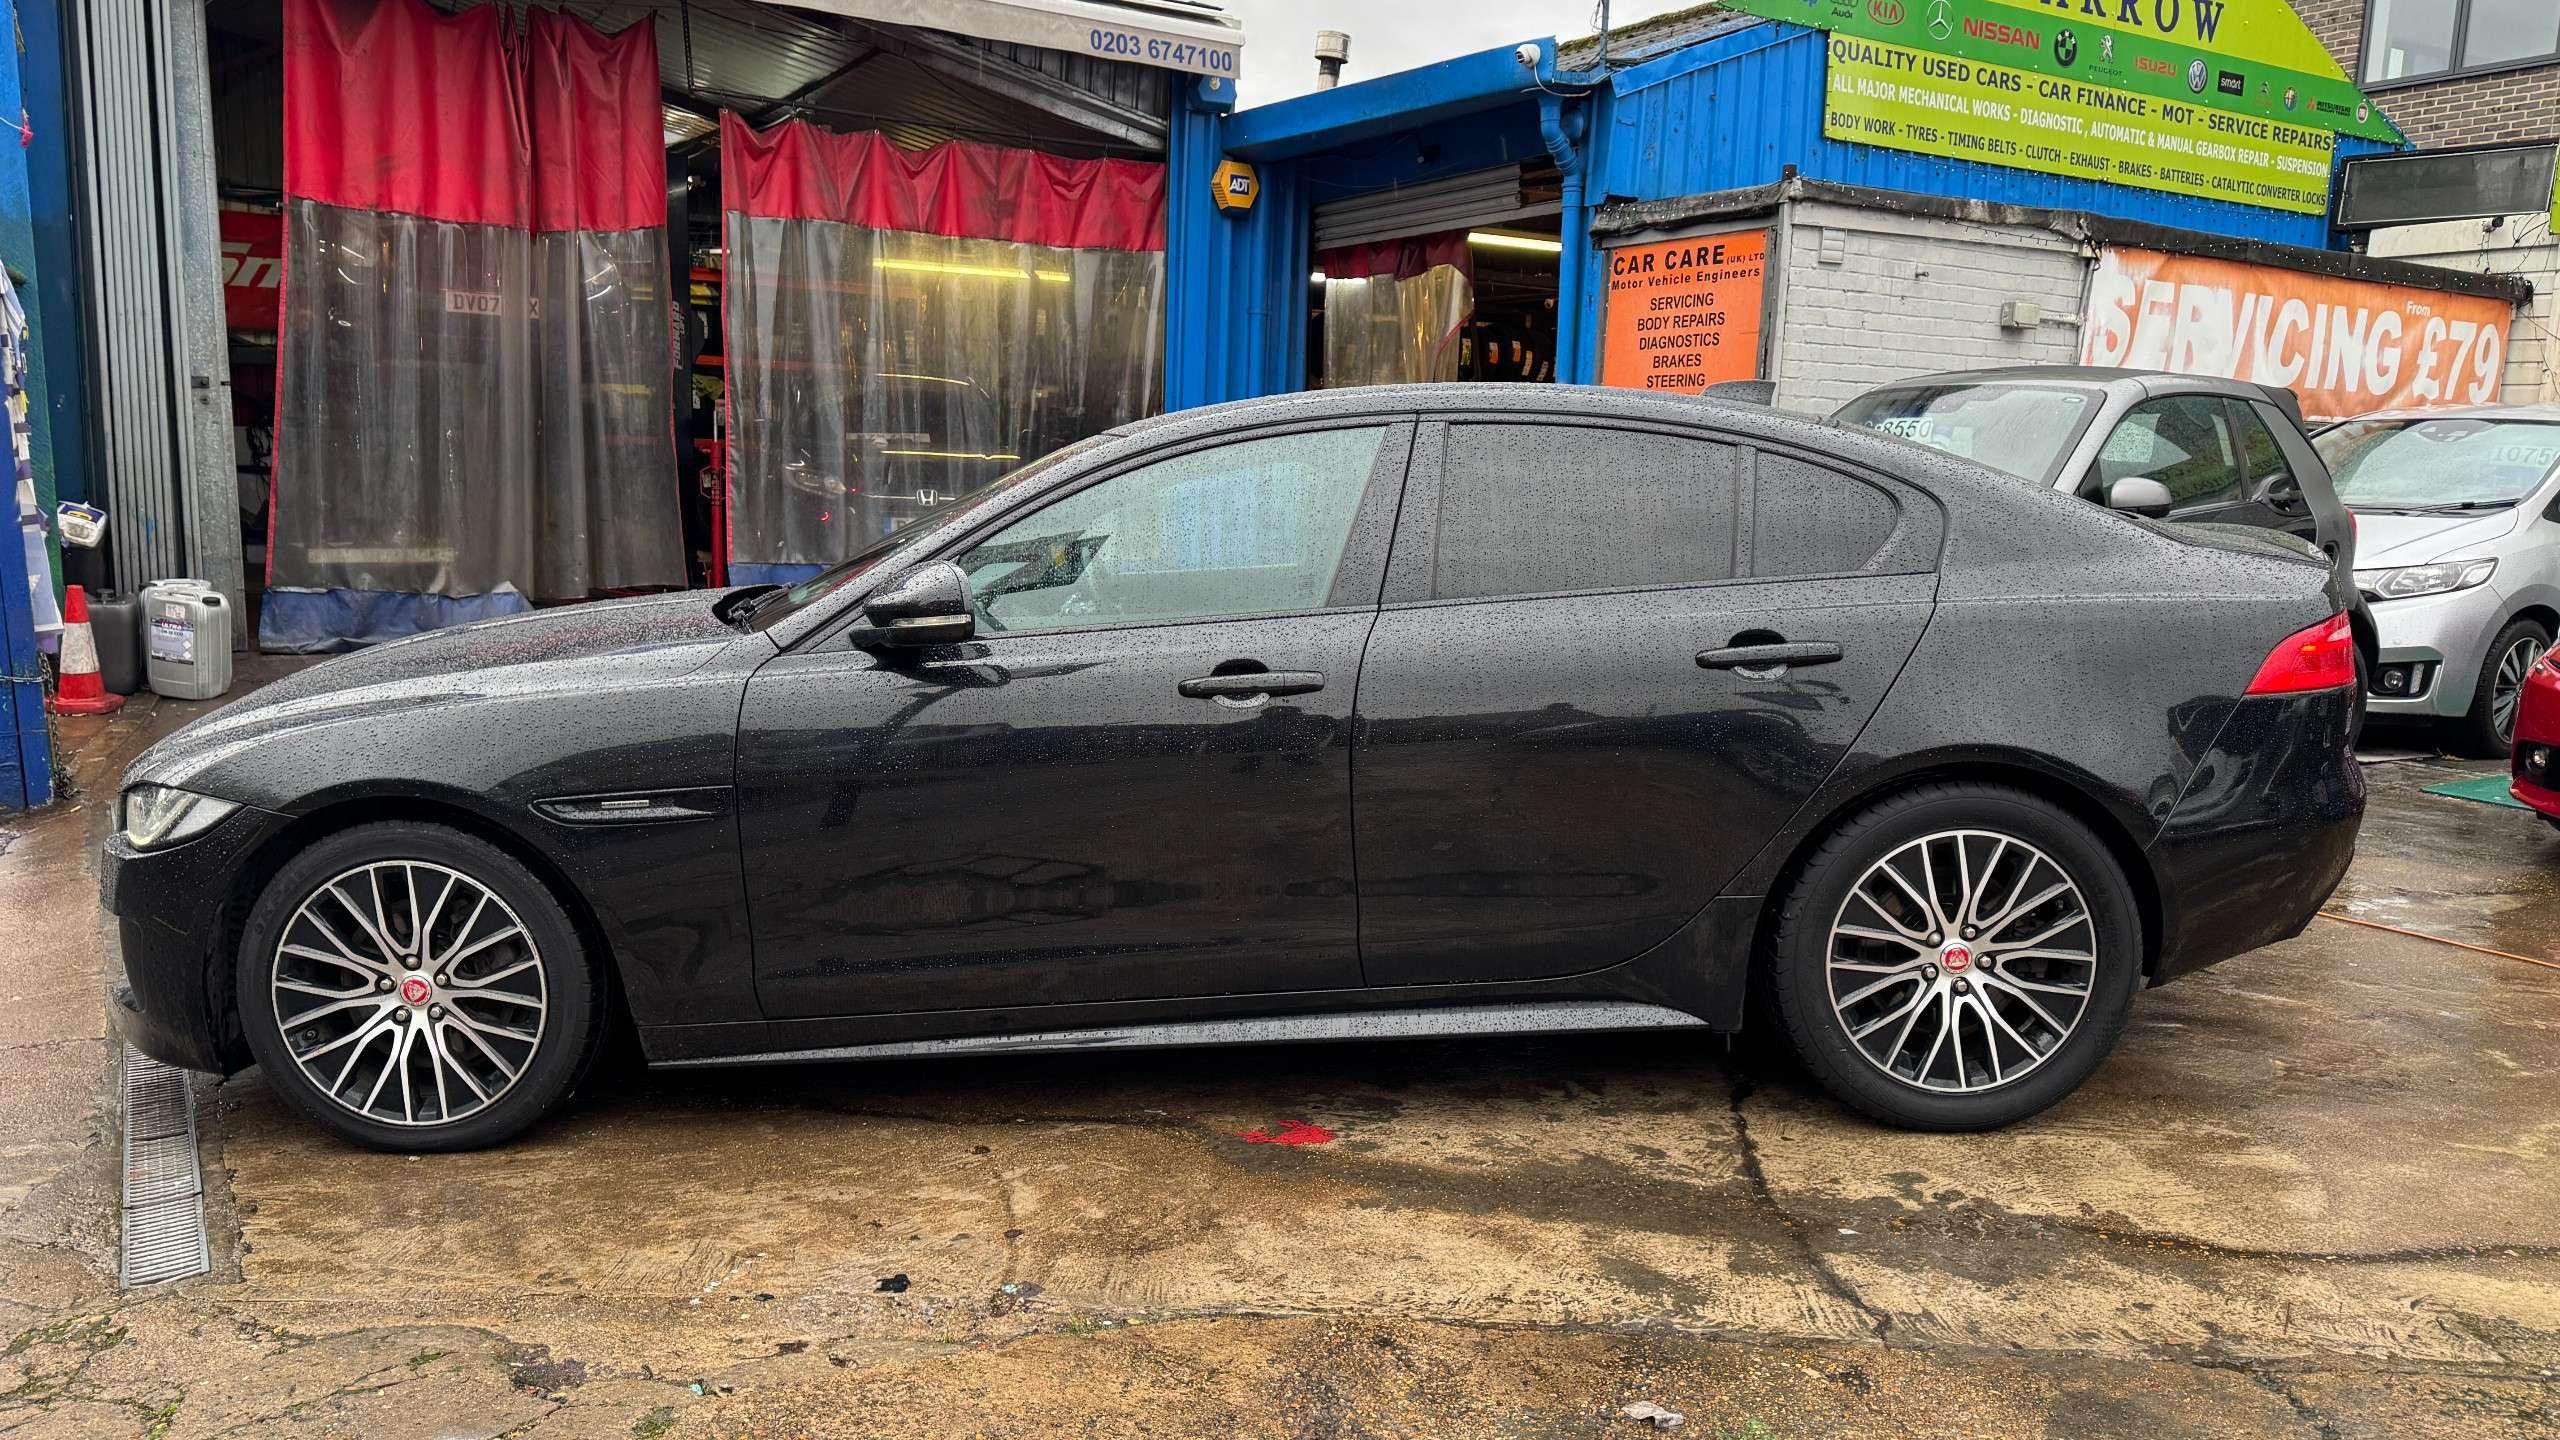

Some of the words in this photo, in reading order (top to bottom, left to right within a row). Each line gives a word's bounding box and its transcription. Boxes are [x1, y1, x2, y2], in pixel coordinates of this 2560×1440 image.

[1831, 7, 1853, 19] Audi
[1873, 1, 1898, 20] KIA
[2040, 0, 2224, 43] ROW
[1963, 16, 2041, 49] NISSAN
[1090, 29, 1141, 56] 0203
[1148, 38, 1233, 71] 6747100
[2088, 64, 2123, 77] PEUGEOT
[2135, 56, 2178, 77] ISUZU
[2220, 77, 2241, 90] smart
[1832, 39, 1917, 72] QUALITY
[1923, 57, 1970, 82] USED
[1976, 68, 2021, 92] CARS
[2039, 80, 2071, 102] CAR
[2077, 88, 2146, 116] FINANCE
[2162, 104, 2194, 125] MOT
[2208, 114, 2268, 139] SERVICE
[2272, 125, 2331, 151] REPAIRS
[1832, 74, 1854, 94] ALL
[1858, 78, 1895, 101] MAJOR
[1899, 86, 1968, 114] MECHANICAL
[1972, 99, 2011, 121] WORKS
[2091, 121, 2145, 146] AUTOMATIC
[2148, 135, 2155, 148] &
[2157, 135, 2194, 155] MANUAL
[2196, 142, 2236, 162] GEARBOX
[2239, 150, 2268, 168] REPAIR
[2276, 155, 2329, 177] SUSPENSION
[1831, 111, 1860, 130] BODY
[1864, 117, 1895, 136] WORK
[1906, 124, 1938, 143] TYRES
[1948, 131, 1985, 151] TIMING
[1988, 139, 2017, 155] BELTS
[2025, 144, 2061, 163] CLUTCH
[2070, 152, 2110, 171] EXHAUST
[2119, 161, 2152, 178] BRAKES
[2160, 168, 2204, 187] BATTERIES
[2211, 176, 2254, 194] CATALYTIC
[2256, 185, 2300, 202] CONVERTER
[2302, 192, 2326, 206] LOCKS
[1230, 177, 1250, 193] ADT
[1613, 253, 1655, 276] CAR
[1664, 244, 1725, 270] CARE
[1726, 255, 1746, 265] (UK)
[1749, 252, 1765, 261] LTD
[1611, 279, 1643, 290] Motor
[1648, 272, 1691, 287] Vehicle
[1696, 267, 1760, 283] Engineers
[453, 293, 500, 312] DV07
[1650, 292, 1714, 311] SERVICING
[2406, 300, 2432, 316] From
[1637, 316, 1669, 331] BODY
[1673, 311, 1725, 329] REPAIRS
[1639, 332, 1720, 350] DIAGNOSTICS
[2095, 270, 2402, 396] SERVICING
[2412, 317, 2500, 403] £79
[1652, 353, 1702, 369] BRAKES
[1646, 373, 1706, 389] STEERING
